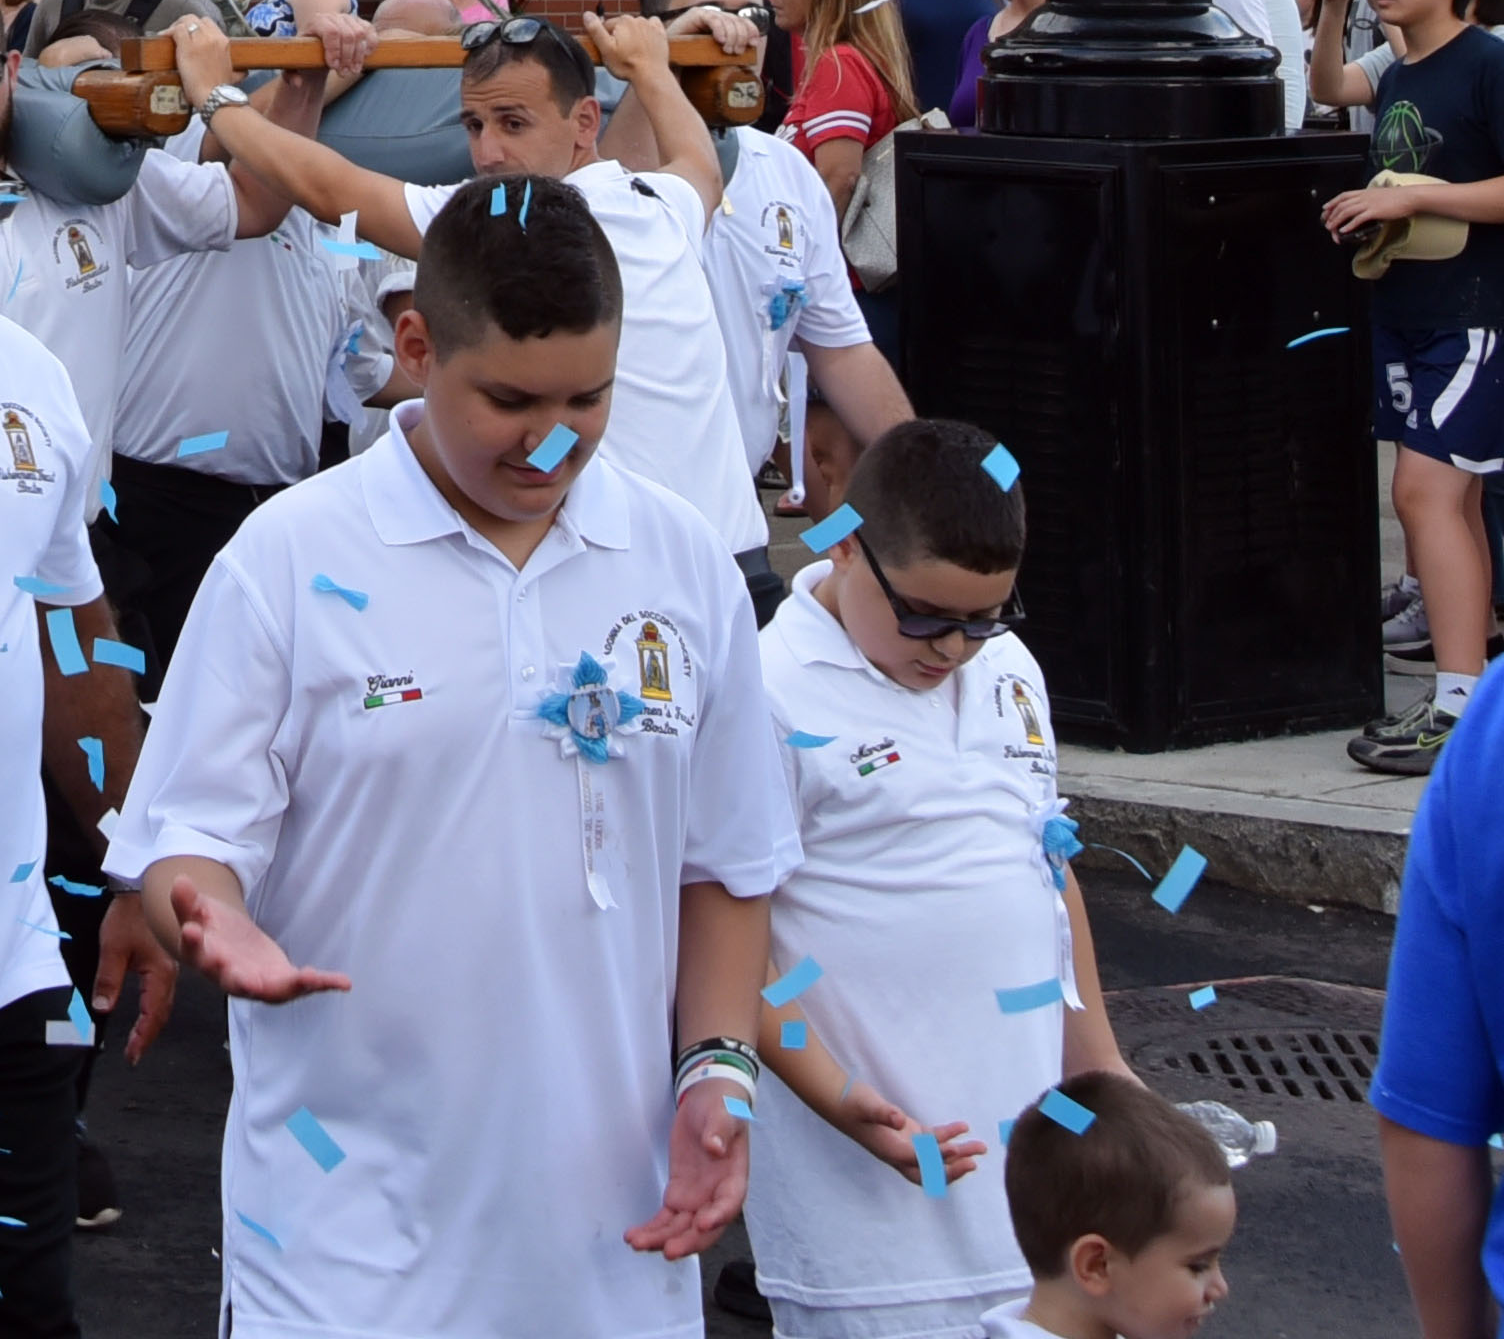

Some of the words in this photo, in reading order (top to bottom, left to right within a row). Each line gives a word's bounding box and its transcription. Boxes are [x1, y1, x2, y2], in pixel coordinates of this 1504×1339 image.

[1385, 362, 1413, 413] 5
[604, 623, 623, 656] ADONNA
[621, 613, 638, 626] DEL
[367, 670, 415, 696] Gianni
[641, 717, 679, 737] Boston
